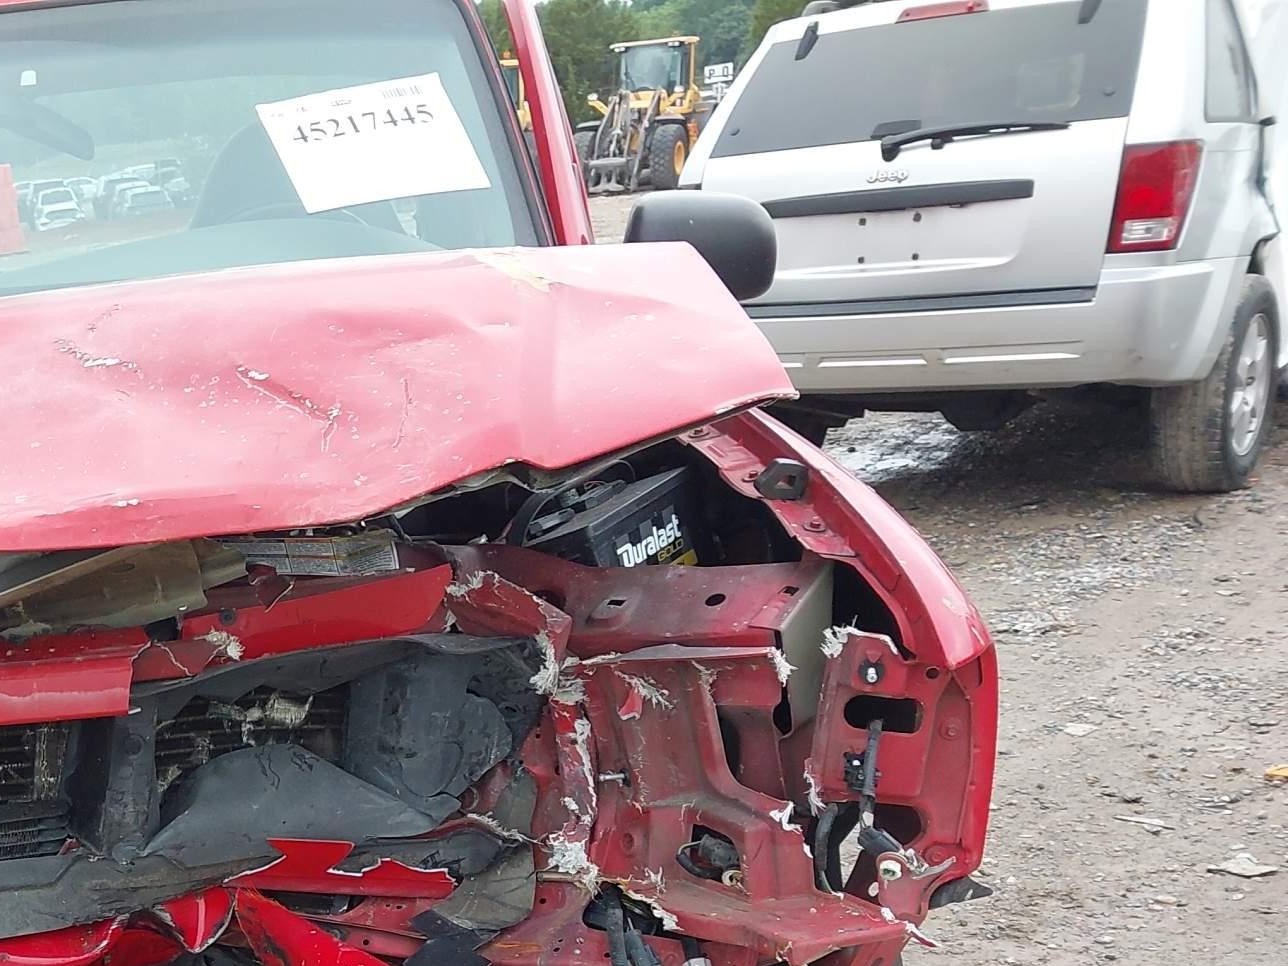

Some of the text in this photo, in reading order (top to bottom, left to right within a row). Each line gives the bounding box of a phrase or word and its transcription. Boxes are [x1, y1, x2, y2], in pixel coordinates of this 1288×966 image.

[292, 103, 434, 143] 45217445
[866, 167, 910, 184] Jeep
[616, 513, 682, 568] Duralast
[657, 538, 684, 562] GOLD
